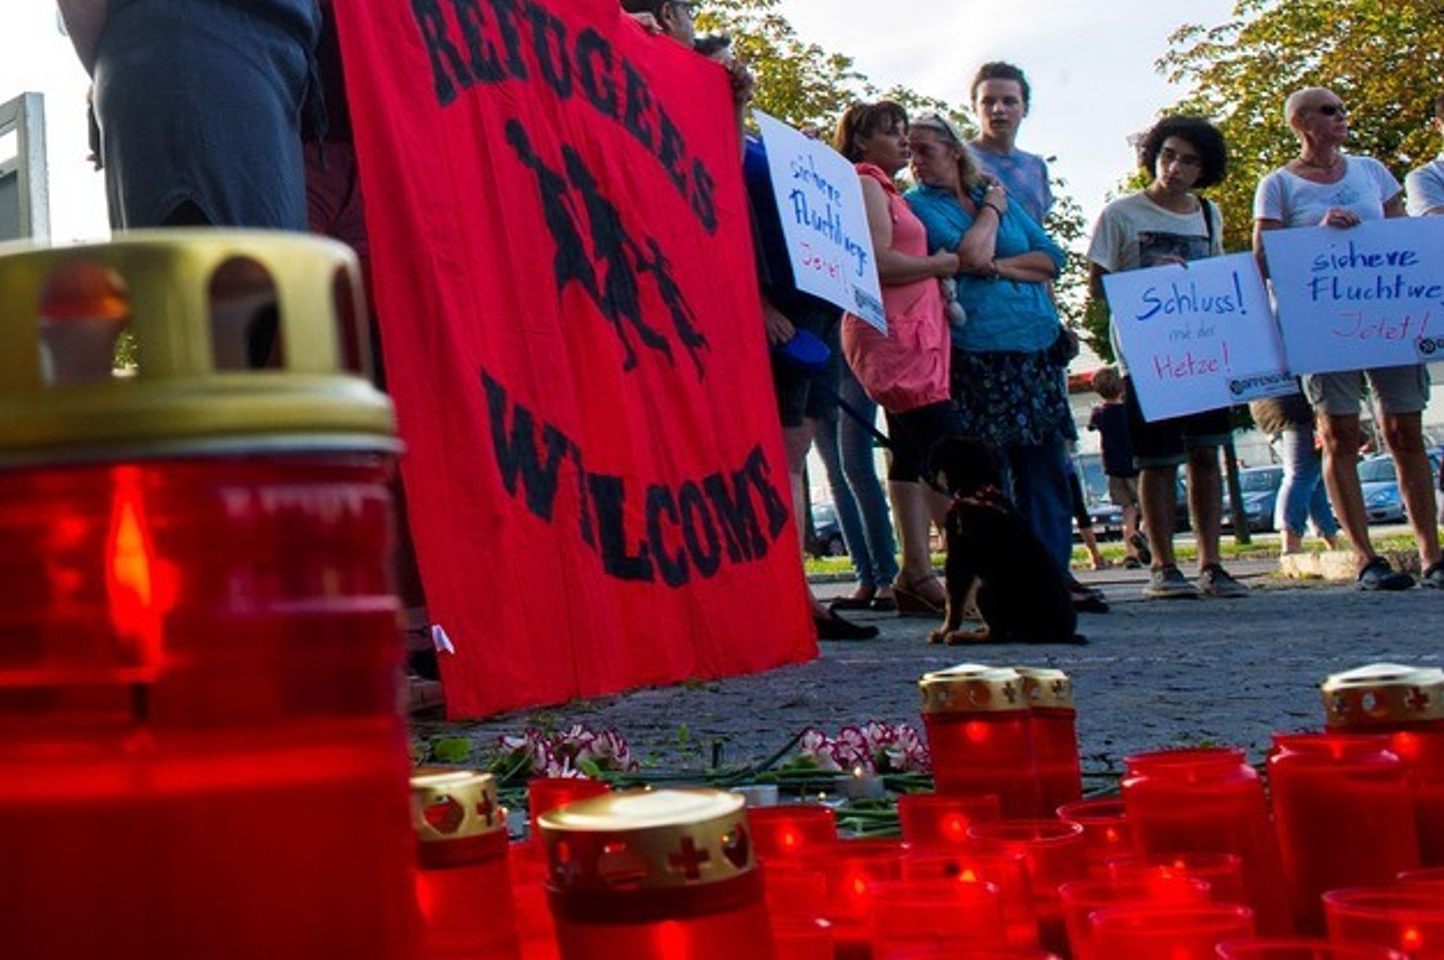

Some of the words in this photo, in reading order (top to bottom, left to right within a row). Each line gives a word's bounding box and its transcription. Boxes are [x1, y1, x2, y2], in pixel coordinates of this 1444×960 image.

[1310, 240, 1420, 272] sichere
[1135, 271, 1247, 321] Schluss!
[1306, 274, 1444, 307] Fluchtwe
[1153, 340, 1231, 381] Hetze!
